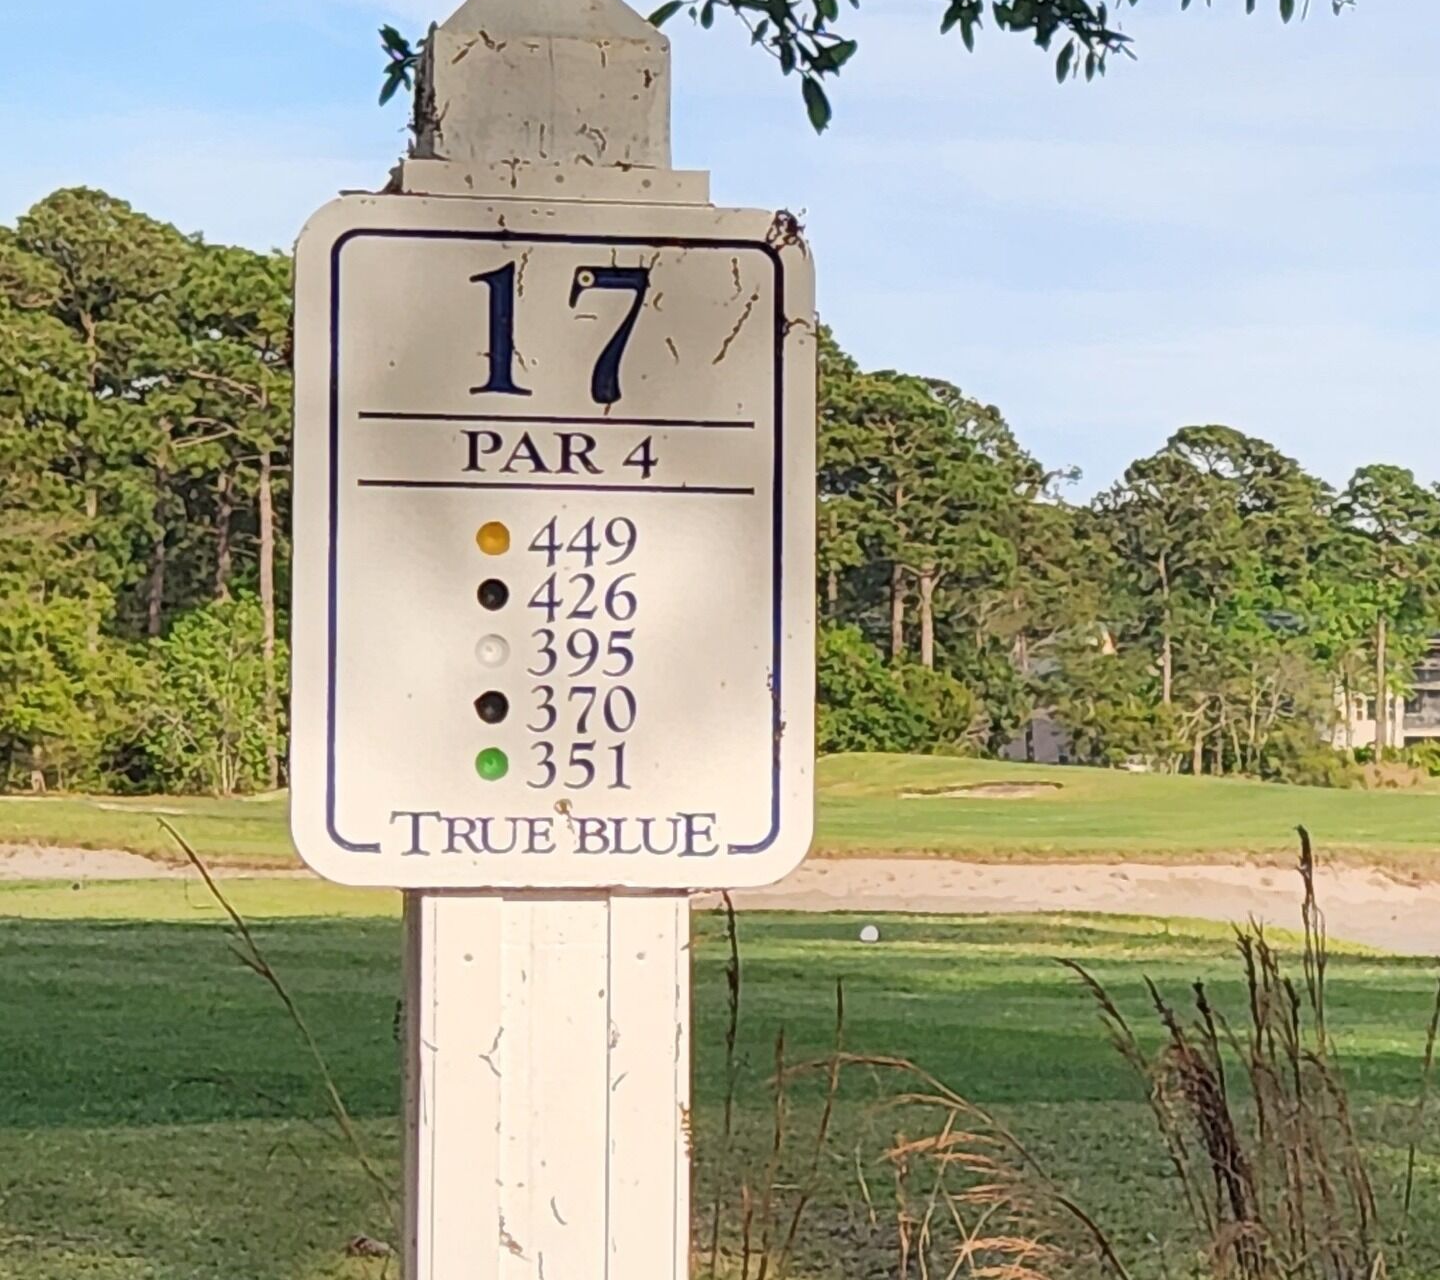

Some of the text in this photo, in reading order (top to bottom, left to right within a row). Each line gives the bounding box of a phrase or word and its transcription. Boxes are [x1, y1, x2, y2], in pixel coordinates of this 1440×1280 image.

[469, 260, 652, 405] 17
[461, 429, 660, 479] PAR 4
[527, 516, 638, 567] 449
[527, 574, 638, 623] 426
[527, 629, 636, 678] 395
[527, 685, 638, 734] 370
[527, 741, 632, 790] 351
[390, 810, 720, 857] TRUE BLUE
